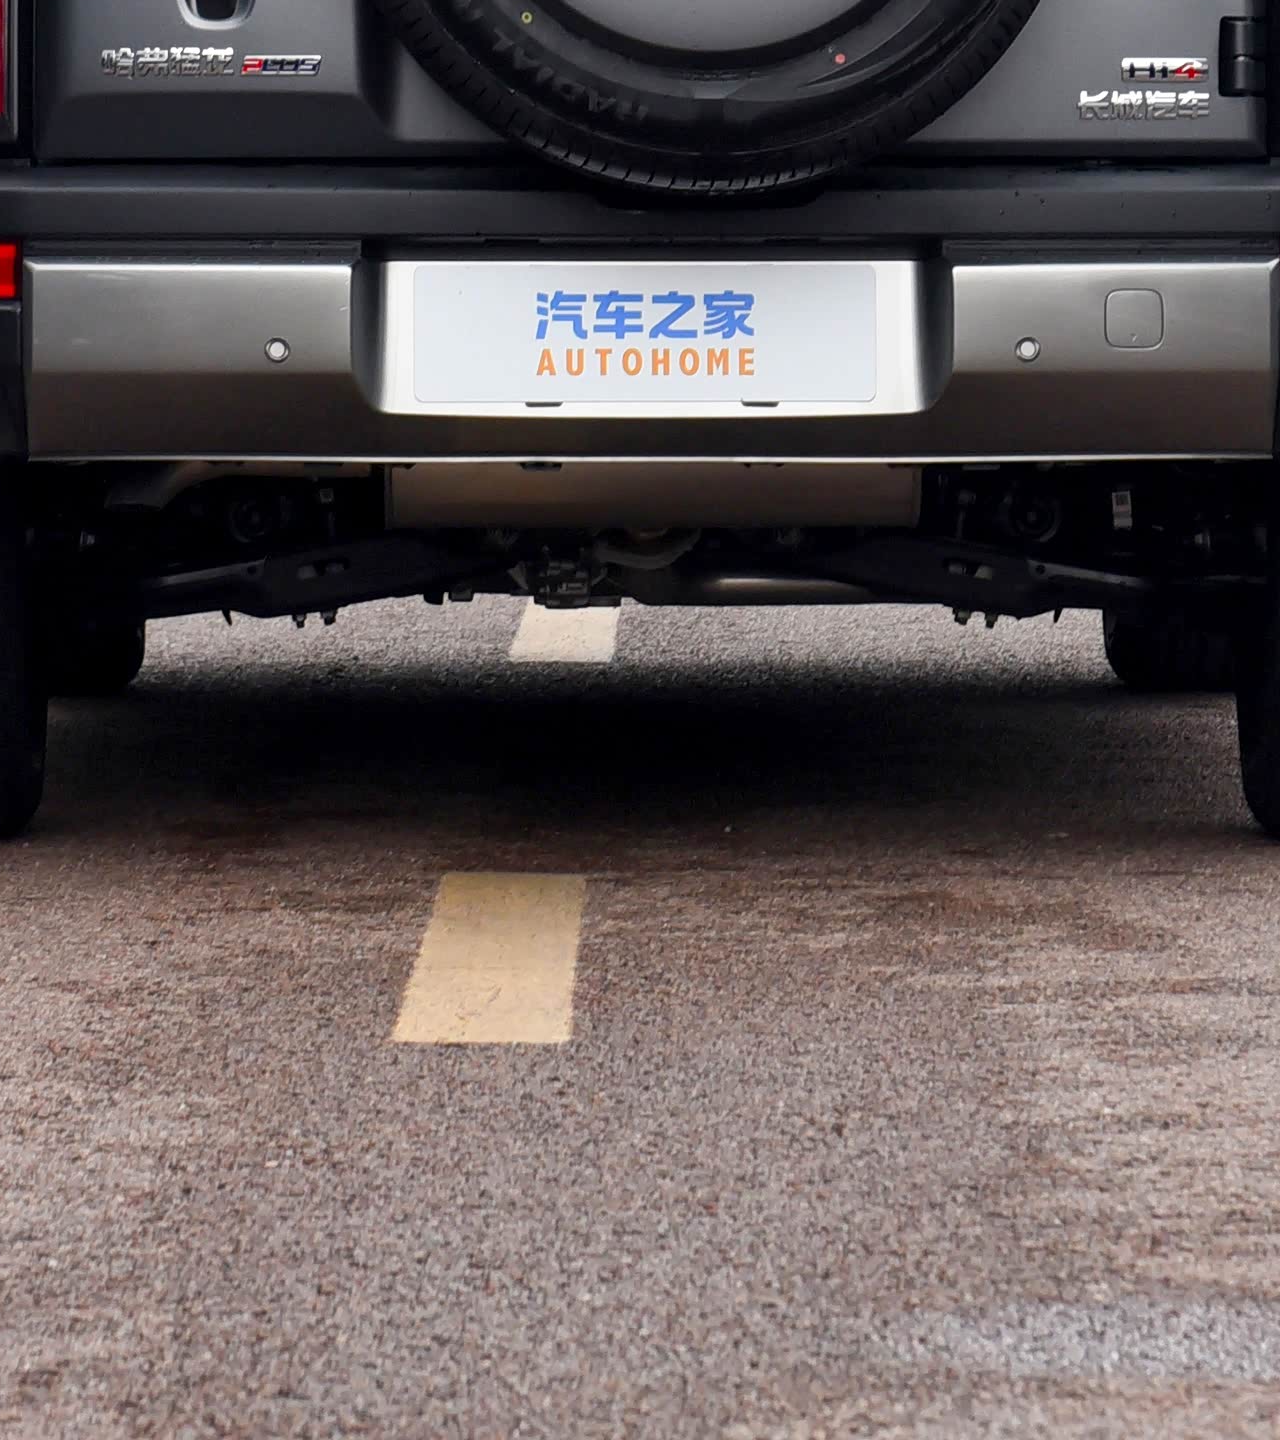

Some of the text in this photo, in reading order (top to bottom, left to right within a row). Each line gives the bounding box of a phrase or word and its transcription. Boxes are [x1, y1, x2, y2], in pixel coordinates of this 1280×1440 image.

[1077, 90, 1211, 121] 长城汽车
[535, 290, 756, 340] 汽车之家
[535, 348, 756, 377] AUTOHOME
